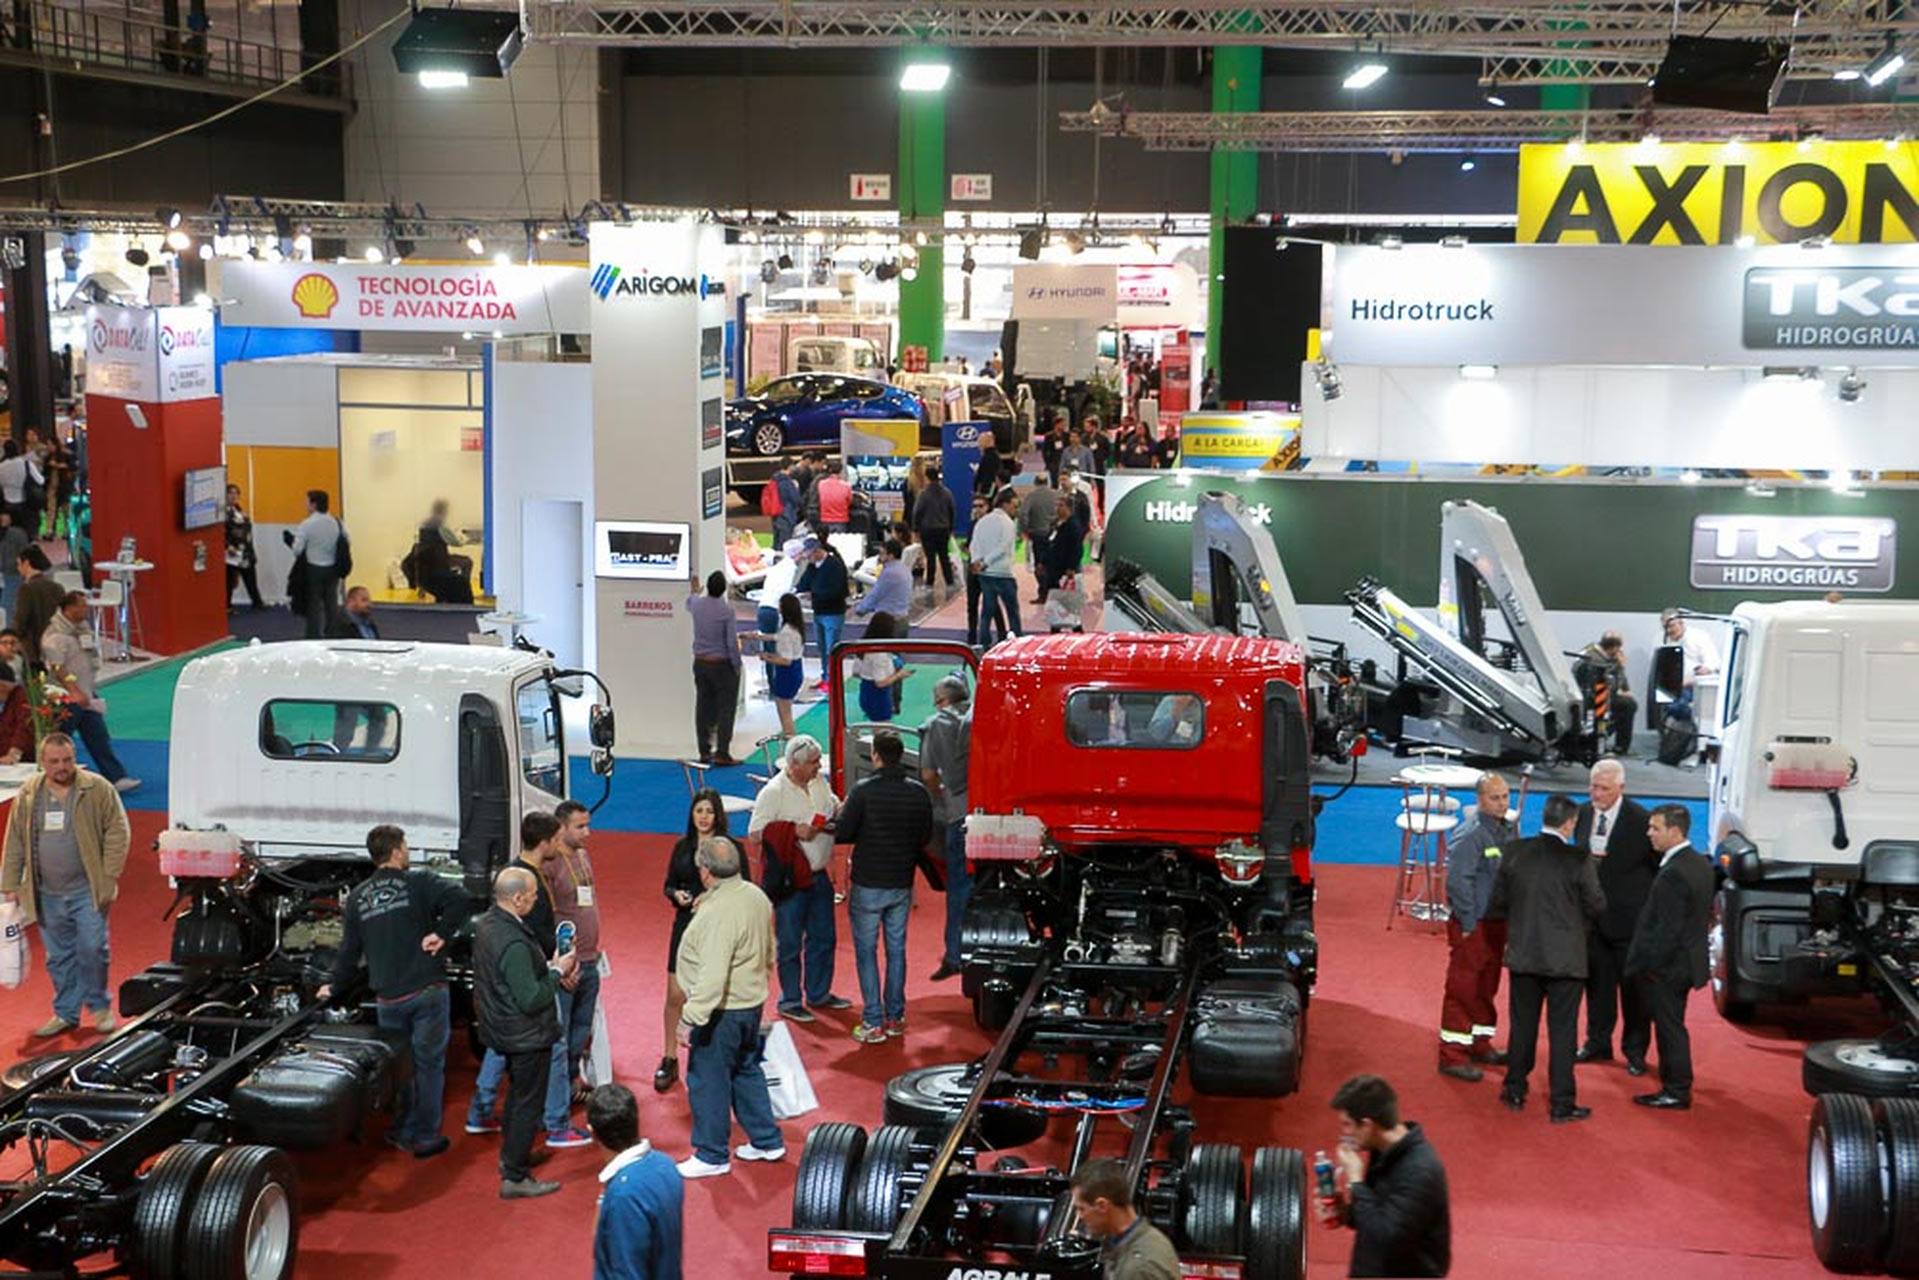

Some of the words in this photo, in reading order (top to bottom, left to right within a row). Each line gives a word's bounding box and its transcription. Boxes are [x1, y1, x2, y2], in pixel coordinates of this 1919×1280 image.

[1534, 162, 1919, 245] AXION
[358, 299, 384, 317] DE
[393, 300, 517, 320] AVANZADA
[1351, 299, 1495, 321] Hidrotruck
[1776, 324, 1919, 346] HIDROGRÚA
[1145, 500, 1273, 524] Hidrck
[1722, 566, 1859, 586] HIDROGRÚAS
